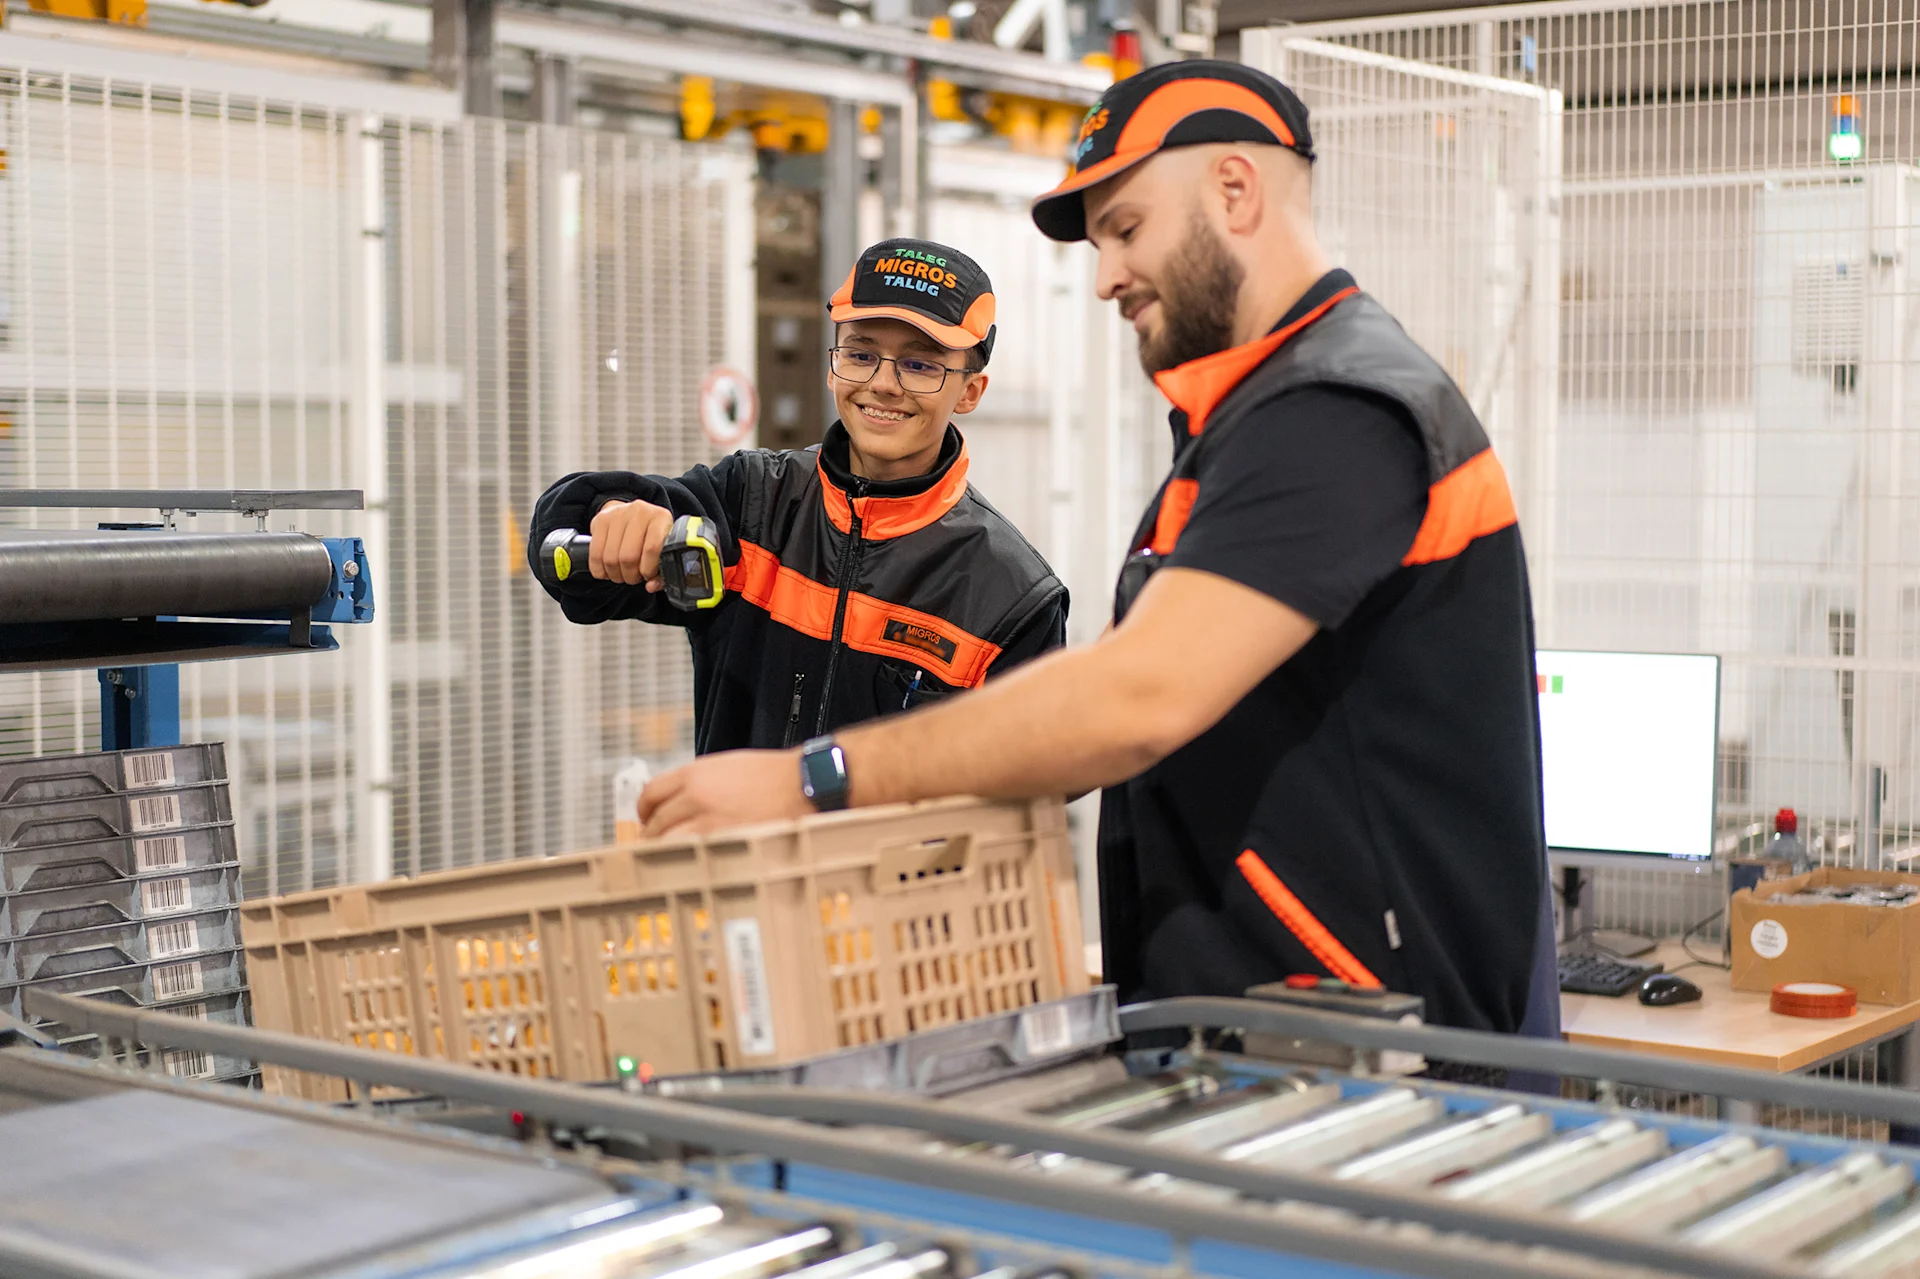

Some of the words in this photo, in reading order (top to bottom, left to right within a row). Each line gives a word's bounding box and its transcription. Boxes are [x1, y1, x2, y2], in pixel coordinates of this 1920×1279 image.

[895, 248, 947, 267] TALEG
[874, 258, 957, 289] MIGROS
[884, 275, 940, 297] TALUG
[906, 625, 941, 645] MIGROS
